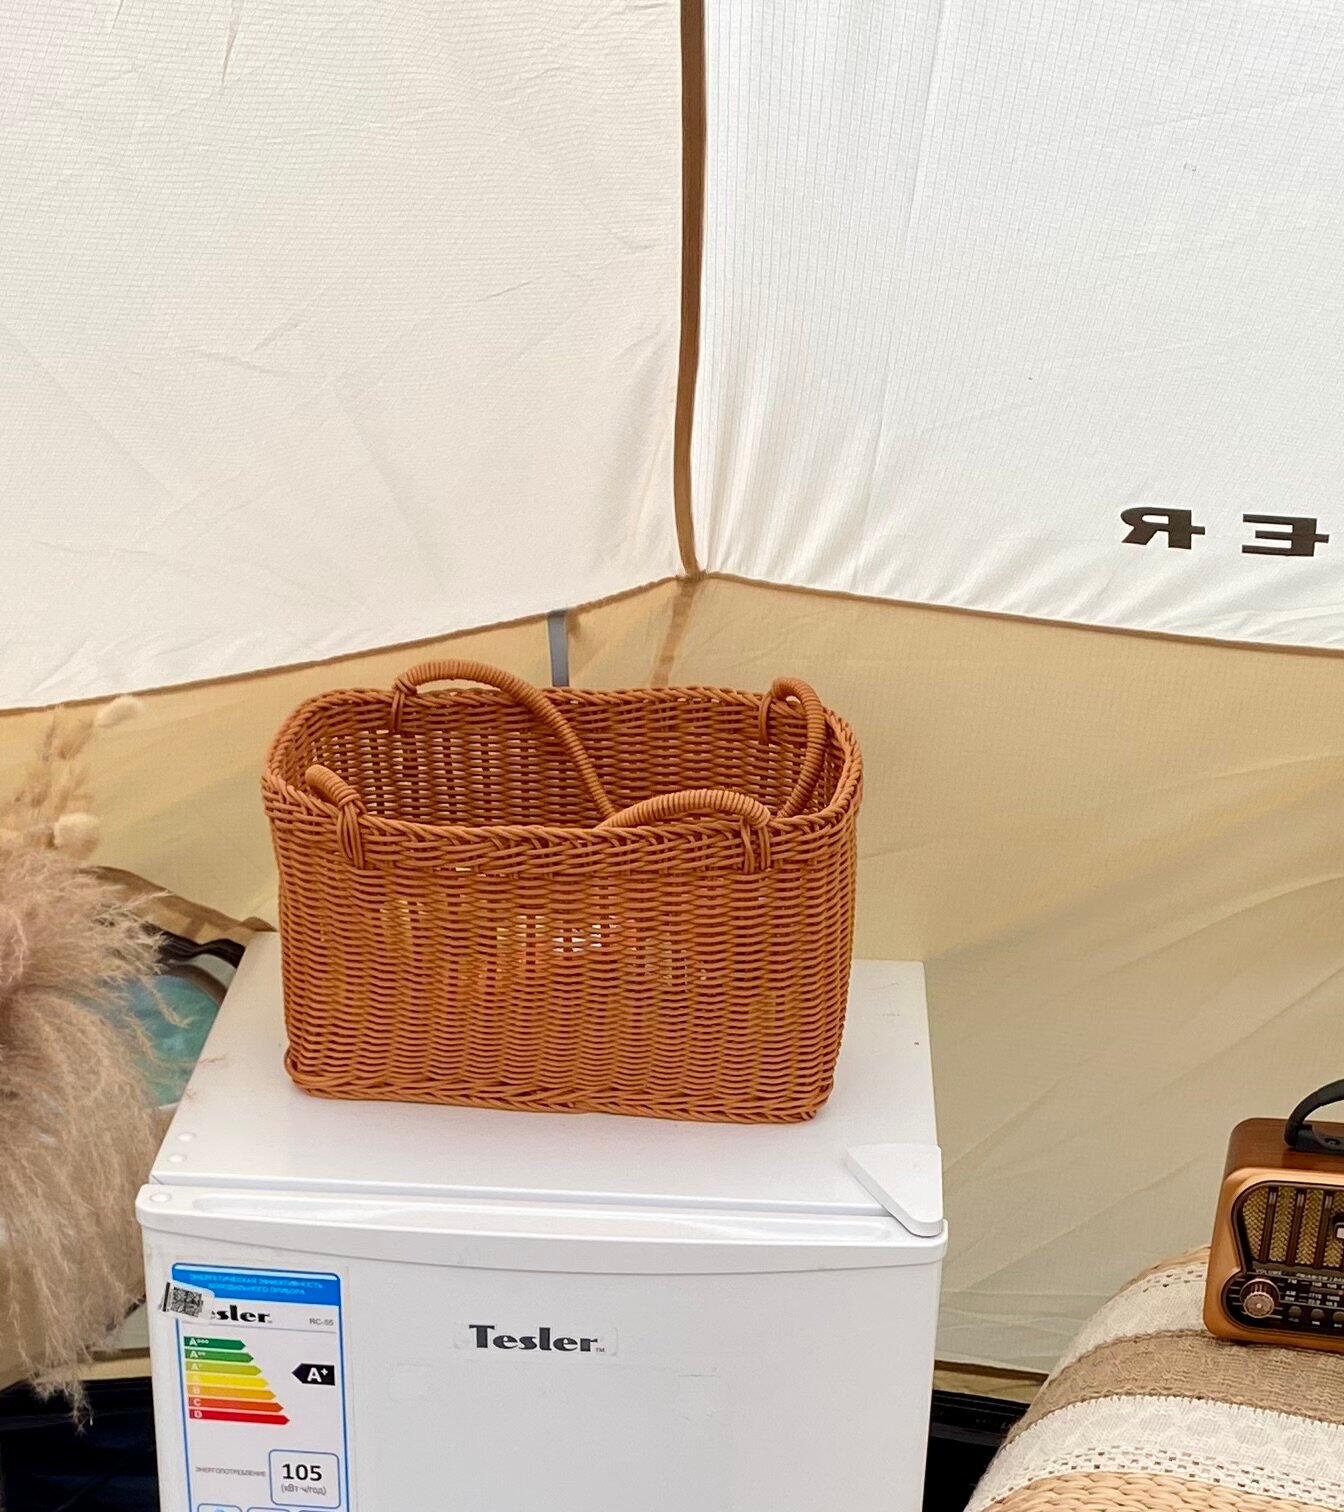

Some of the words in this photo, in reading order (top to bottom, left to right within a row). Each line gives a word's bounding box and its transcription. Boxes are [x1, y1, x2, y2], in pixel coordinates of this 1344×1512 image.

[210, 1304, 270, 1323] sler
[468, 1324, 598, 1352] Tesler
[307, 1367, 328, 1383] A+
[193, 1398, 201, 1406] C
[194, 1410, 203, 1418] D
[282, 1463, 322, 1481] 105
